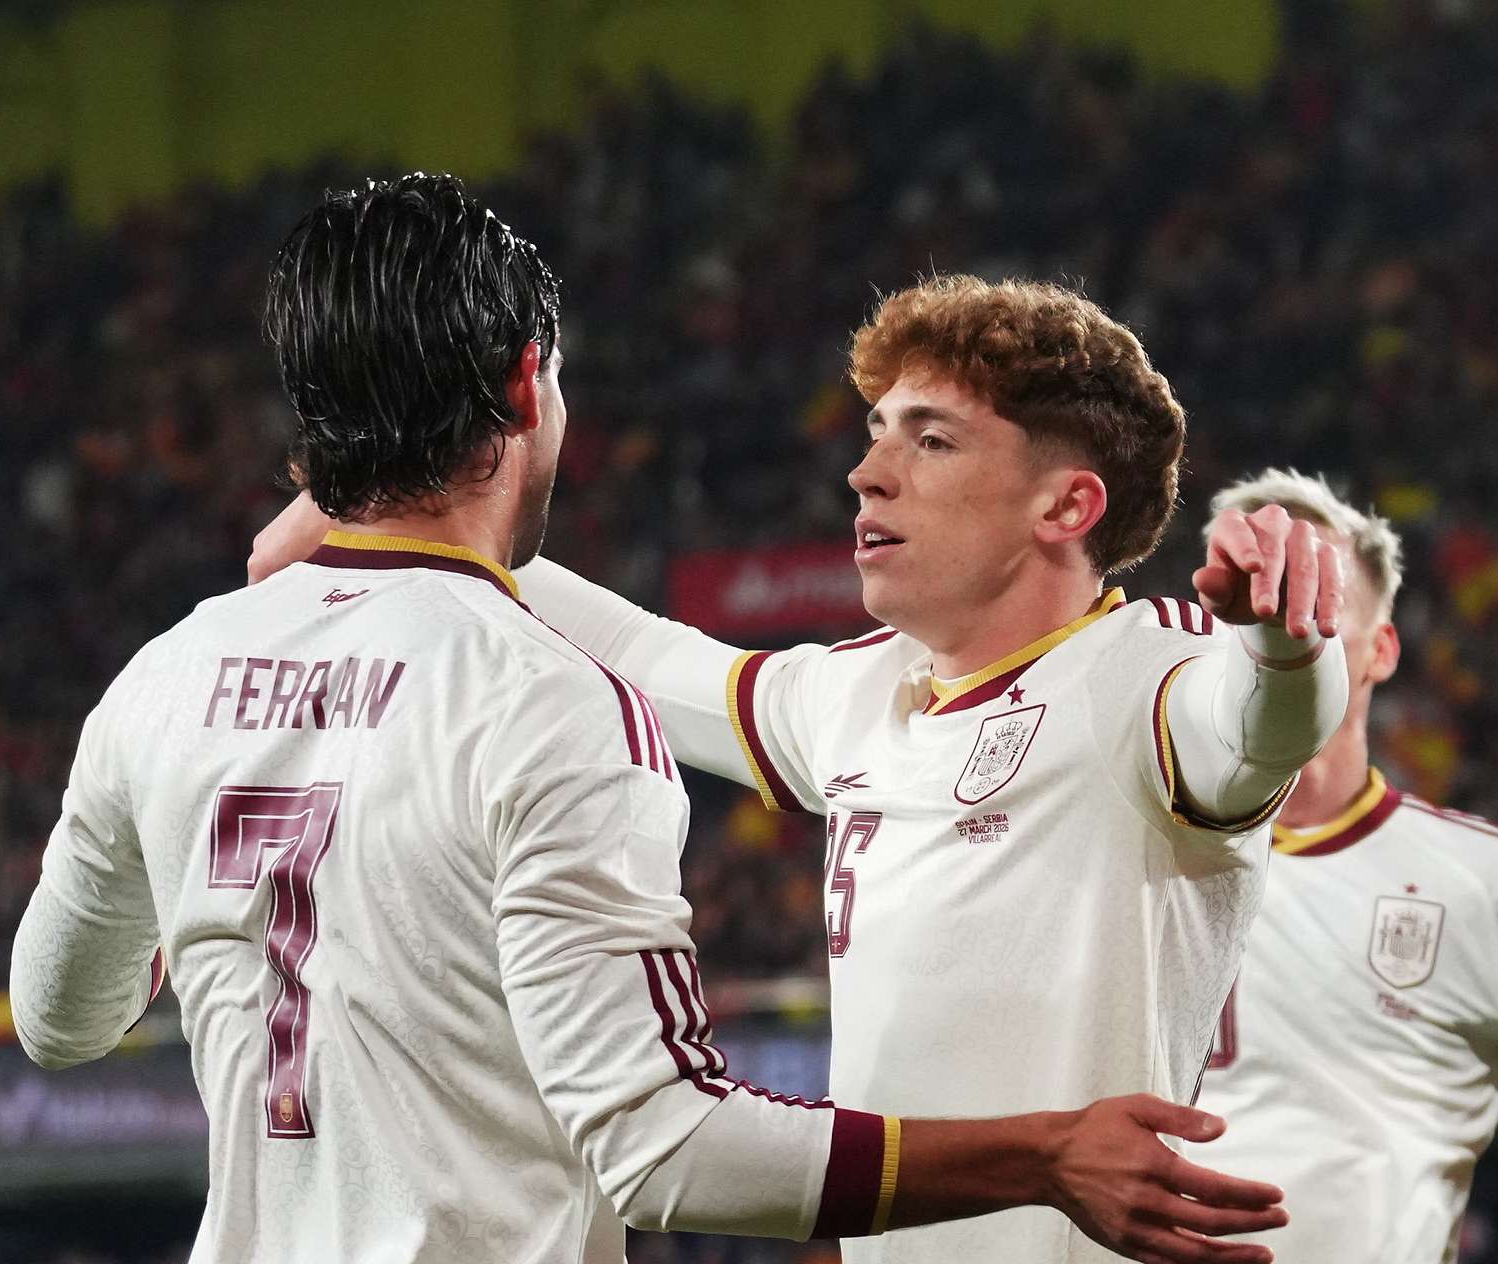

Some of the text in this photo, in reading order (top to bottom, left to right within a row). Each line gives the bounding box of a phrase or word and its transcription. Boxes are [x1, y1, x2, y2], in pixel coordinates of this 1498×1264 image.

[203, 656, 406, 731] FERRAN
[955, 818, 977, 829] SPAIN
[983, 813, 1009, 824] SERBIA
[958, 823, 1010, 837] 27 MARCH 2026
[824, 811, 884, 959] 5
[207, 781, 343, 1139] 7
